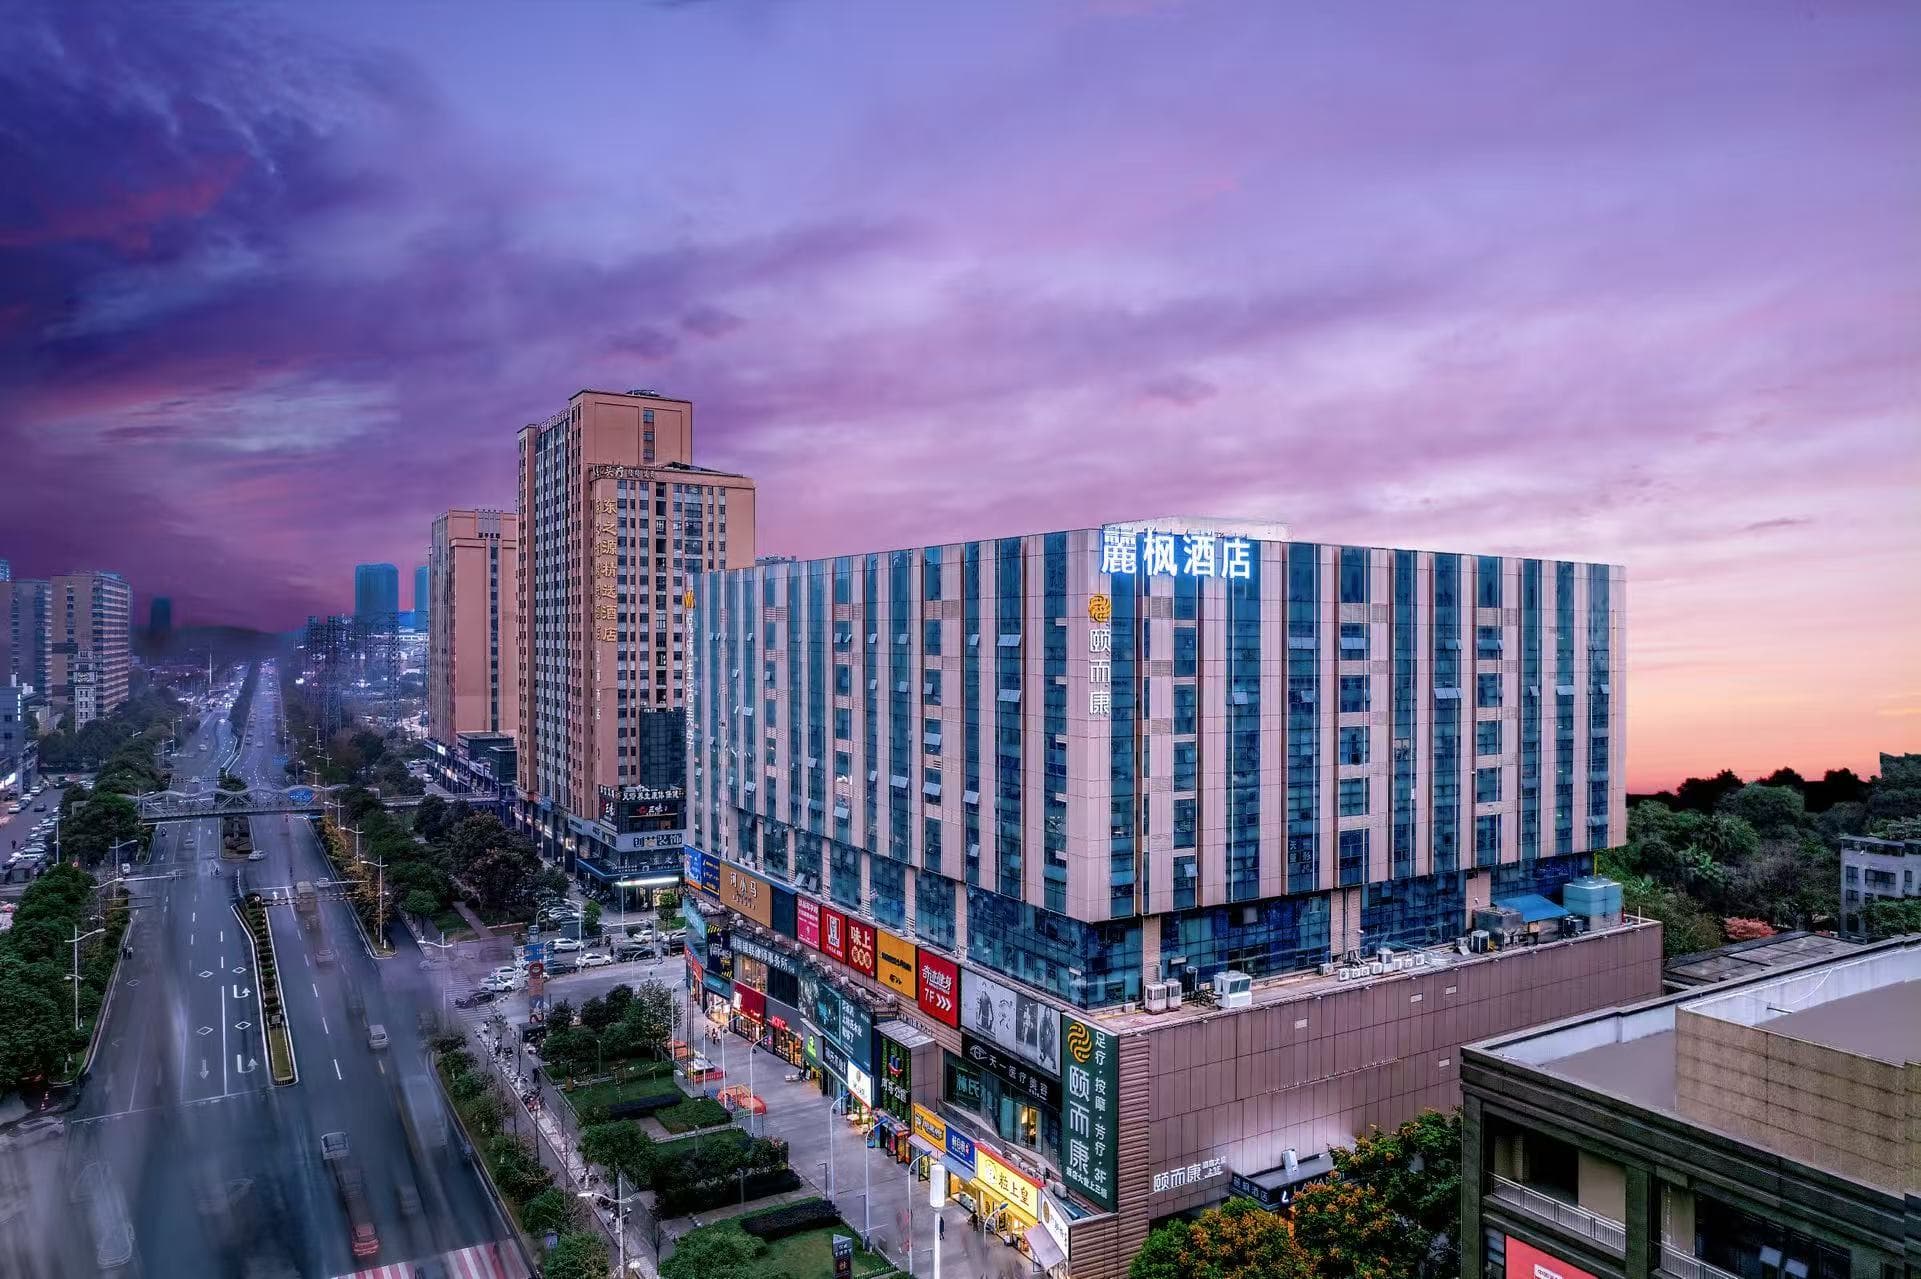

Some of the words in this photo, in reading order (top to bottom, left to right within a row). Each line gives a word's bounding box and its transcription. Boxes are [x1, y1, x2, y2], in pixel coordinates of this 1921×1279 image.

[1088, 629, 1111, 715] 颐而康
[924, 987, 935, 1004] 7F
[989, 1054, 1048, 1101] 天一医疗美容
[1069, 1064, 1090, 1175] 颐而康
[1153, 1163, 1202, 1193] 颐而康
